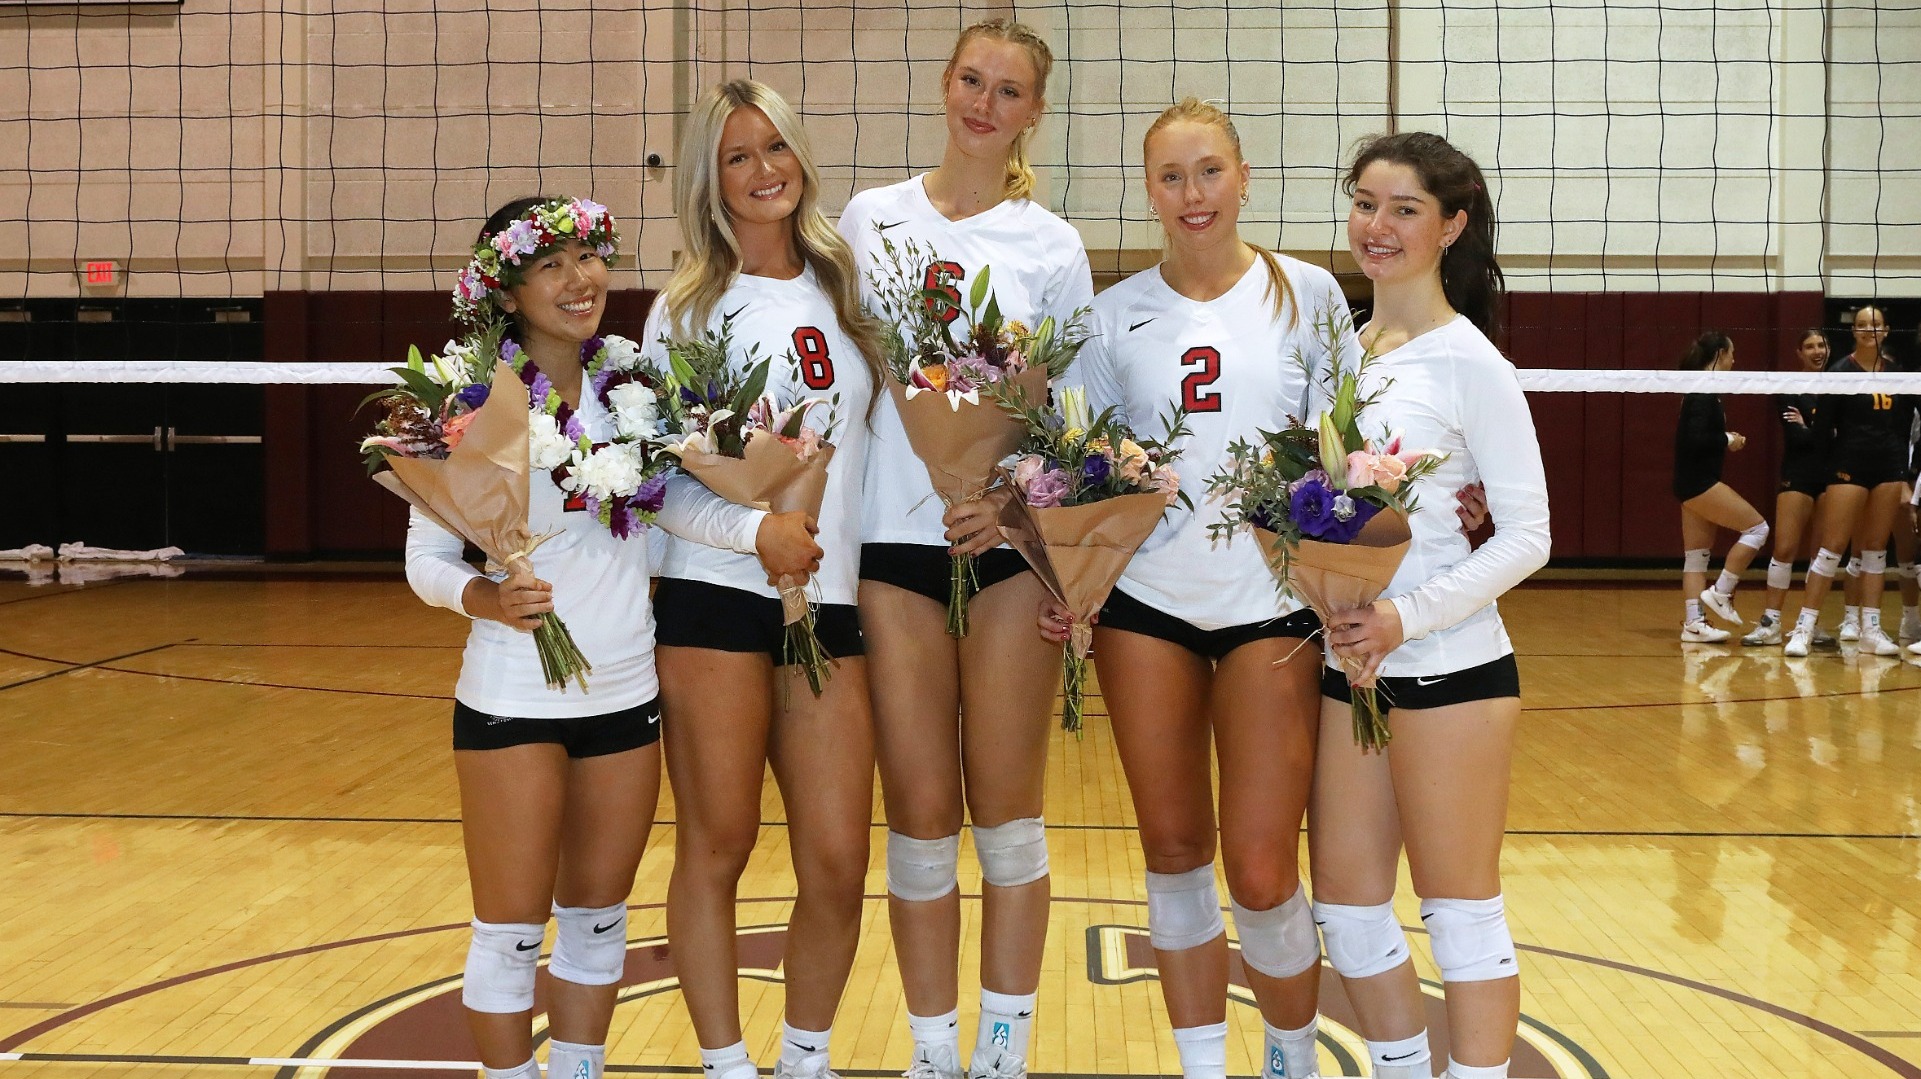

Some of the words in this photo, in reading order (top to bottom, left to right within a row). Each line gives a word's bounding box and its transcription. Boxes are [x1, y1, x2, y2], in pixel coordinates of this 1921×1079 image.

[87, 261, 113, 283] EXIT
[922, 260, 965, 326] 6
[791, 326, 835, 390] 8
[1181, 346, 1221, 414] 2
[1872, 393, 1892, 410] 16
